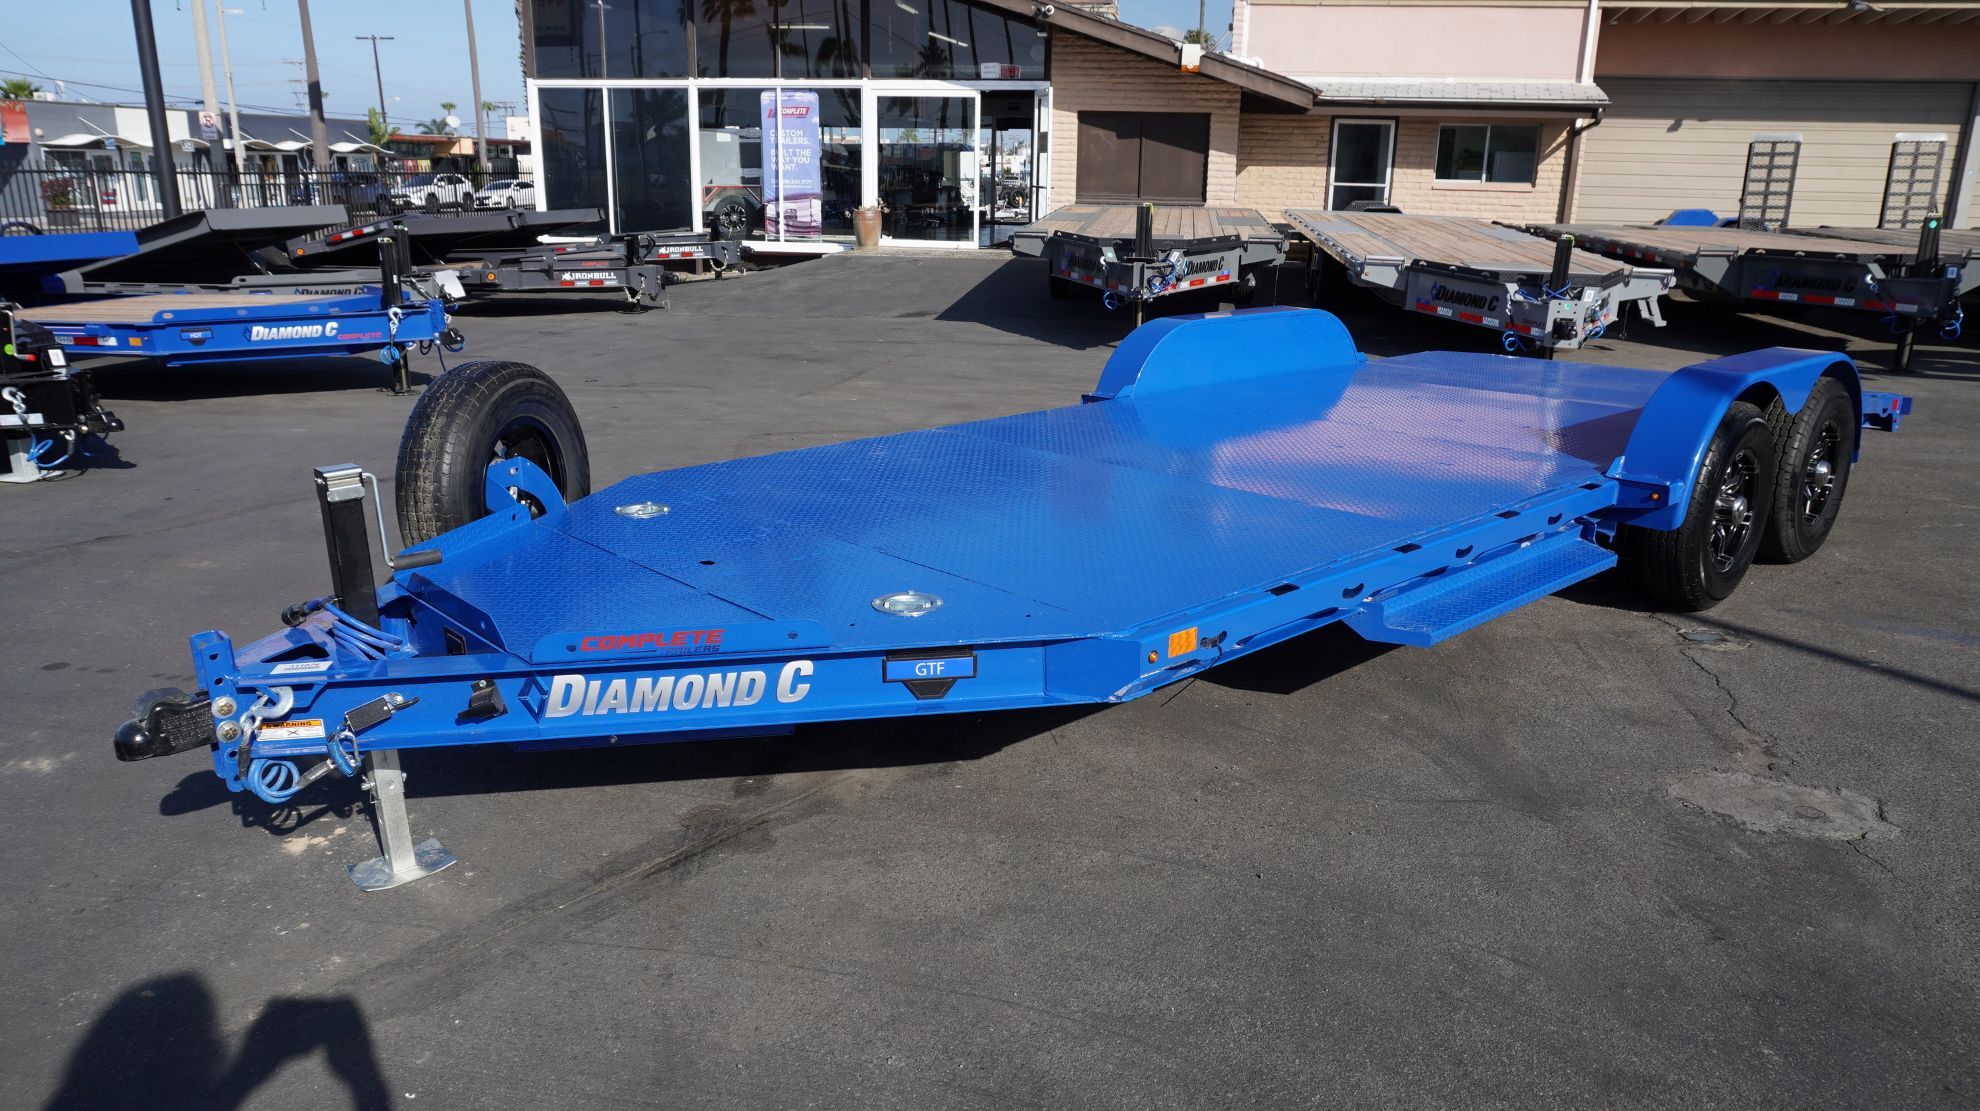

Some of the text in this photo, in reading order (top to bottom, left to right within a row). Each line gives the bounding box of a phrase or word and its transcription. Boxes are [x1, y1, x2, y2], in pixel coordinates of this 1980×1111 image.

[770, 129, 803, 137] CSTOM
[770, 137, 810, 145] TAILERS.
[770, 149, 811, 157] BLT THE
[792, 156, 810, 164] YOU
[1187, 258, 1218, 276] DIAMOND
[1217, 256, 1225, 270] C
[572, 272, 617, 280] IRONBULL
[1436, 284, 1500, 312] DIAMOND C
[250, 324, 323, 342] DIAMOND
[324, 321, 339, 337] C
[580, 629, 726, 652] COMPLETE
[658, 644, 720, 657] TRAILERS
[914, 661, 945, 676] GTF
[545, 659, 814, 718] DIAMOND C
